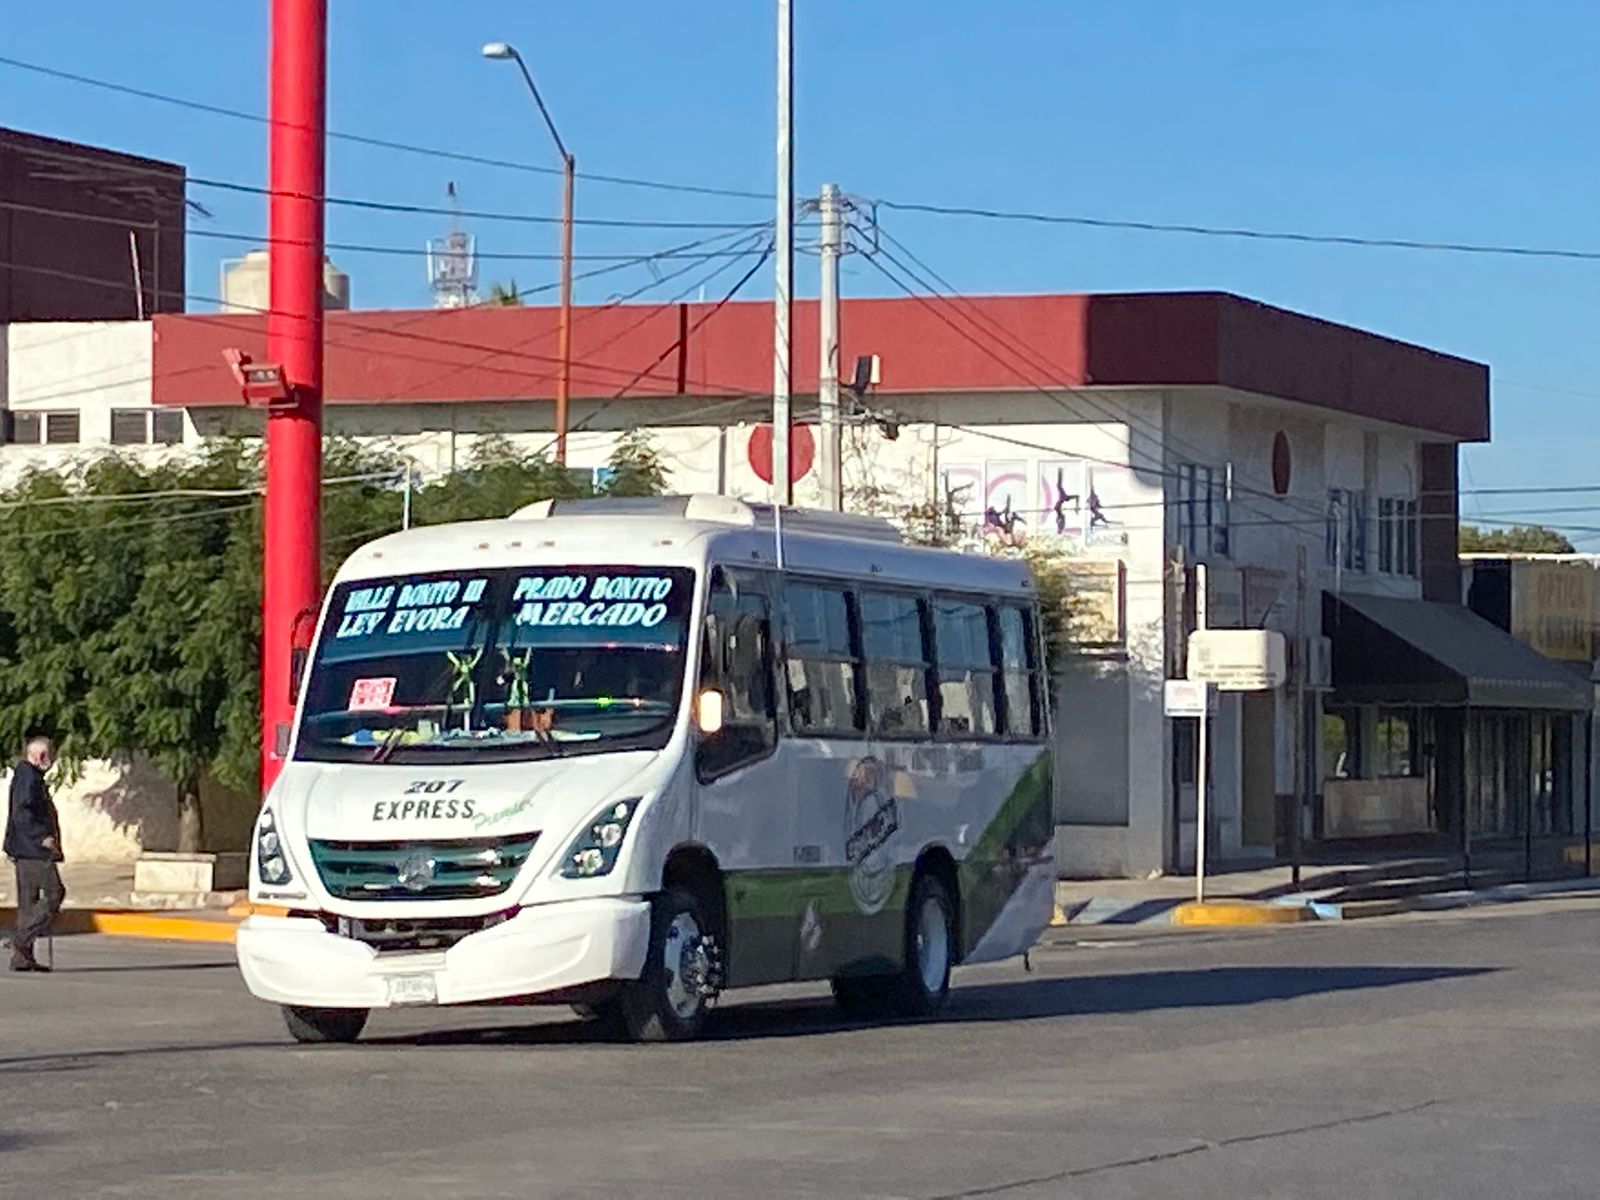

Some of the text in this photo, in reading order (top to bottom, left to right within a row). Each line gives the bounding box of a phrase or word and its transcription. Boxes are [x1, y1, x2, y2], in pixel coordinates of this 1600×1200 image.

[513, 575, 586, 601] PRADO
[336, 604, 470, 639] LEY EVORA
[514, 601, 667, 627] MERCADO
[404, 779, 465, 795] 207
[373, 798, 475, 821] EXPRESS
